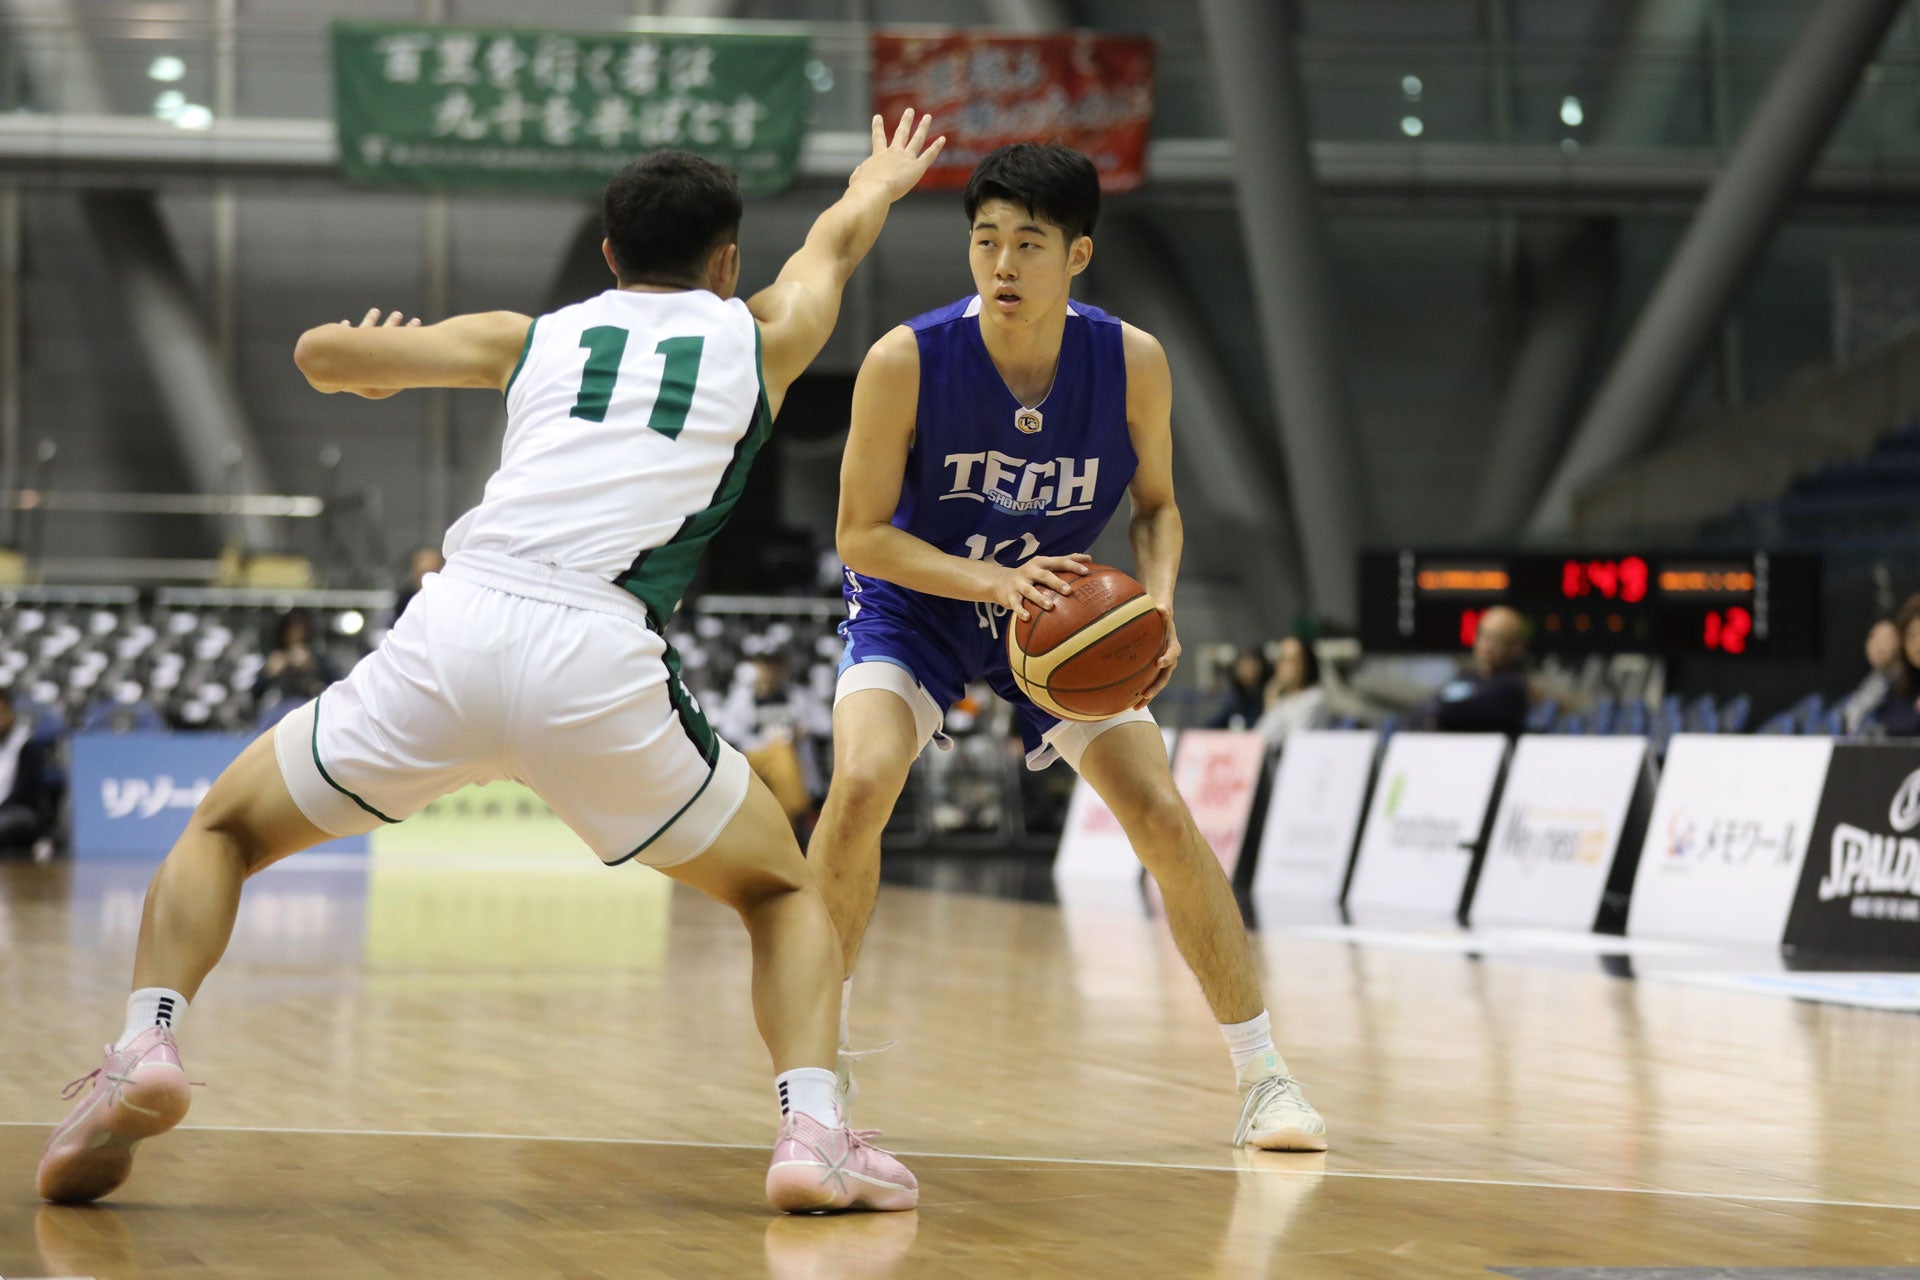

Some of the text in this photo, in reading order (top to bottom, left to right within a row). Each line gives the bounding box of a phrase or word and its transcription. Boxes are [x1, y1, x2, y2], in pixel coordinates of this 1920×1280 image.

[569, 325, 705, 441] 11
[944, 450, 1100, 508] TECH
[987, 489, 1046, 511] SHONAN
